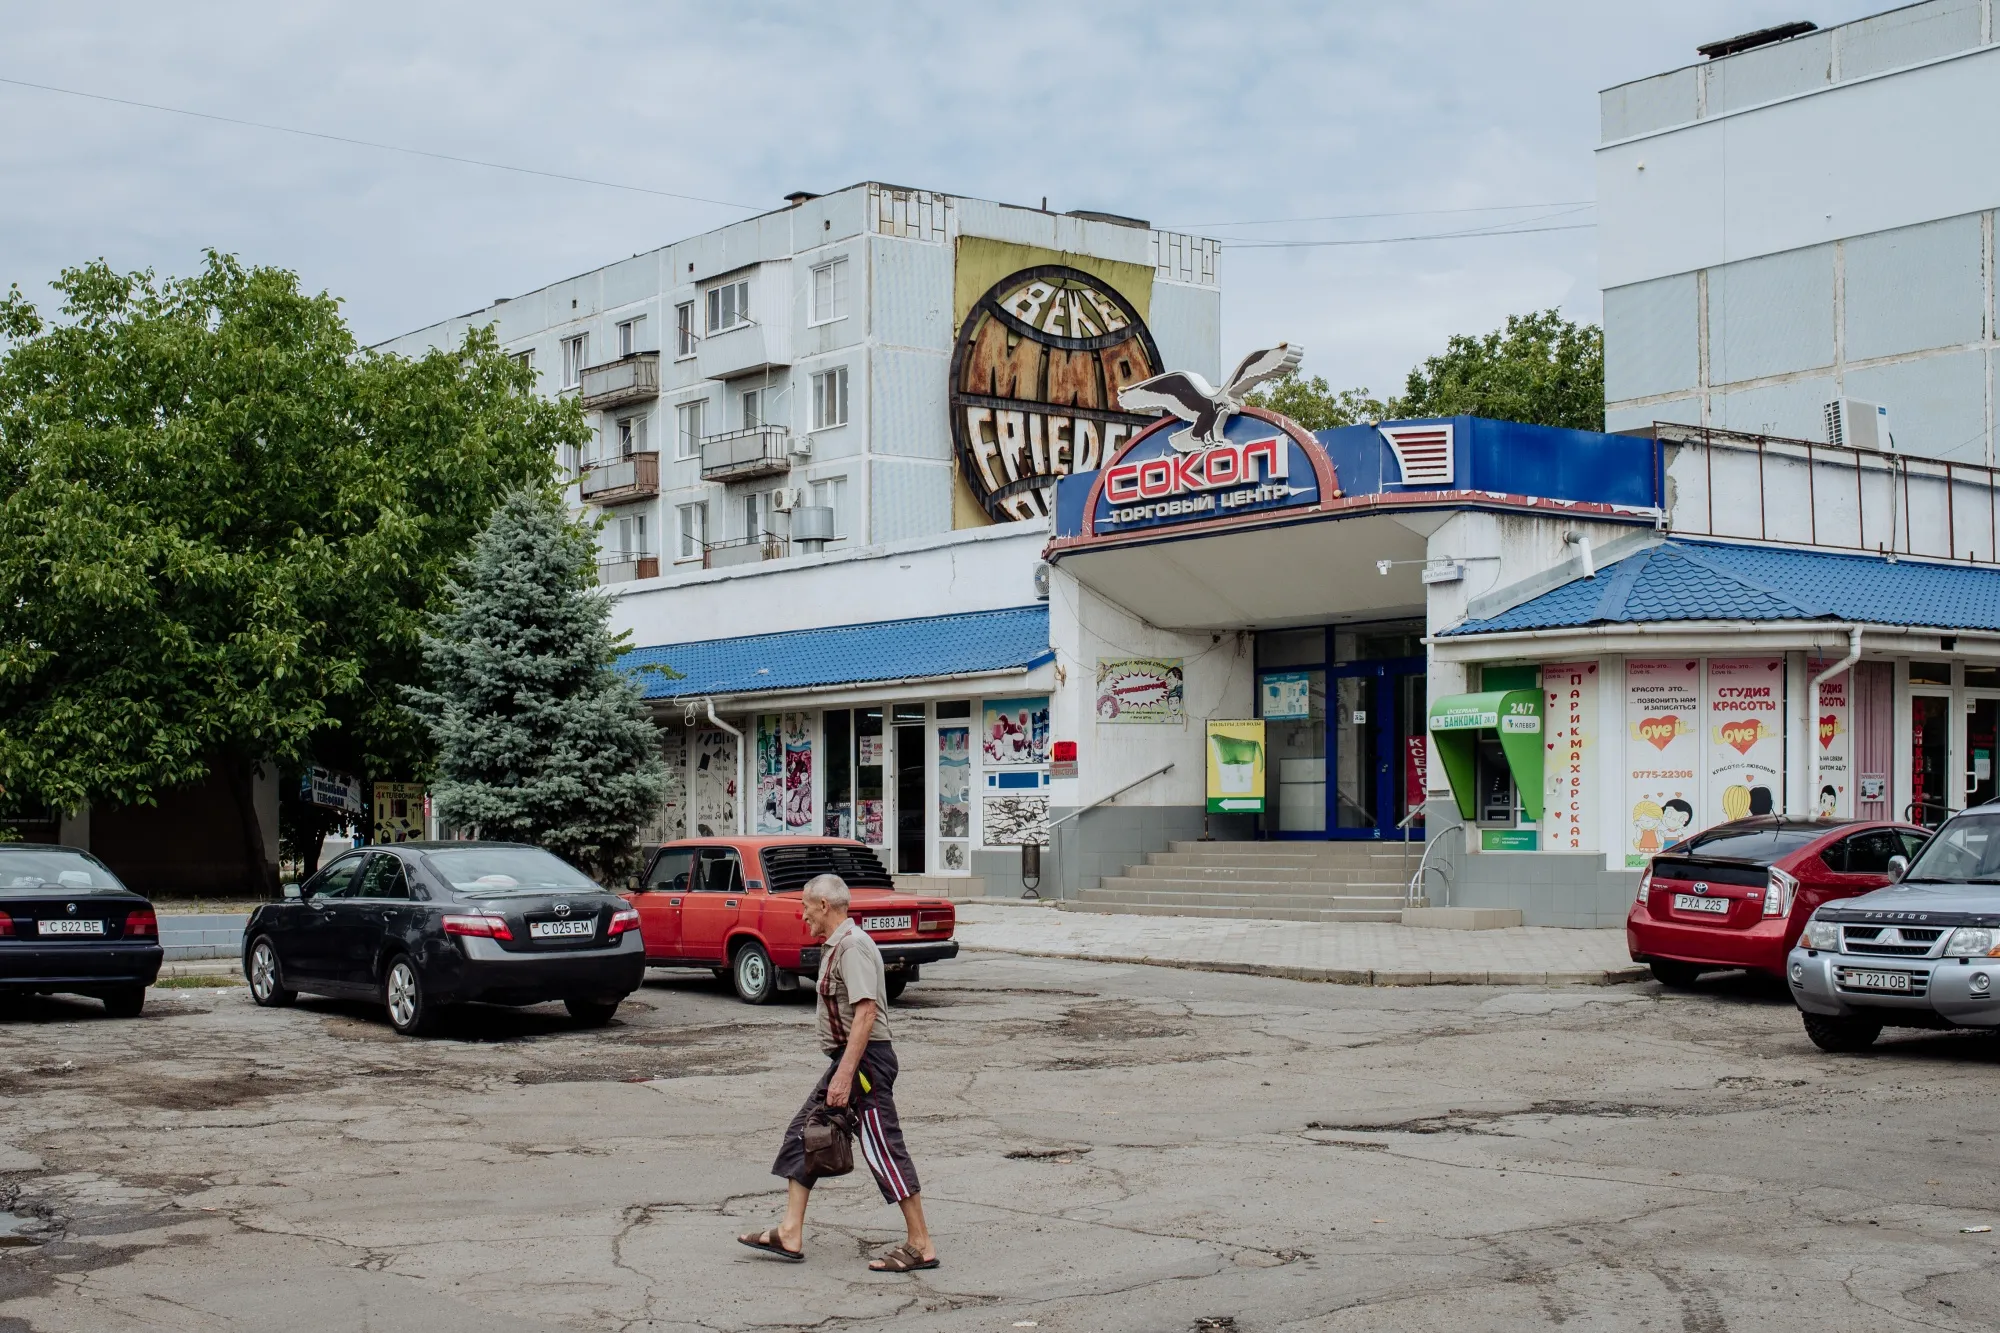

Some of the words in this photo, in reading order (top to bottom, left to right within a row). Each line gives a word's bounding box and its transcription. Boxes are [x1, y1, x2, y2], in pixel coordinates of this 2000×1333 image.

[967, 316, 1154, 413] МИР
[967, 408, 1145, 494] FRIEDE
[1109, 494, 1215, 524] ТОРГОВЫЙ
[1221, 484, 1289, 508] ЦЕНТР
[1718, 687, 1771, 699] СТУДИЯ
[1713, 701, 1776, 711] КРАСОТЫ
[1819, 696, 1846, 707] АСОТЫ
[1510, 703, 1534, 715] 24/7
[1444, 714, 1482, 728] БАНКОМАТ
[1630, 721, 1671, 741] Love
[1712, 724, 1754, 746] Love
[1570, 673, 1583, 848] ПАРИКМАХЕРСКАЯ
[1632, 770, 1693, 779] 0775-22306
[392, 784, 405, 792] ВСЕ
[1704, 899, 1722, 911] 225
[1865, 912, 1928, 920] PAJERO
[61, 921, 81, 932] 822
[84, 921, 100, 932] BE
[552, 922, 572, 934] 025
[574, 921, 589, 933] EM
[879, 918, 895, 928] 683
[897, 917, 909, 927] AH
[1866, 974, 1886, 987] 221
